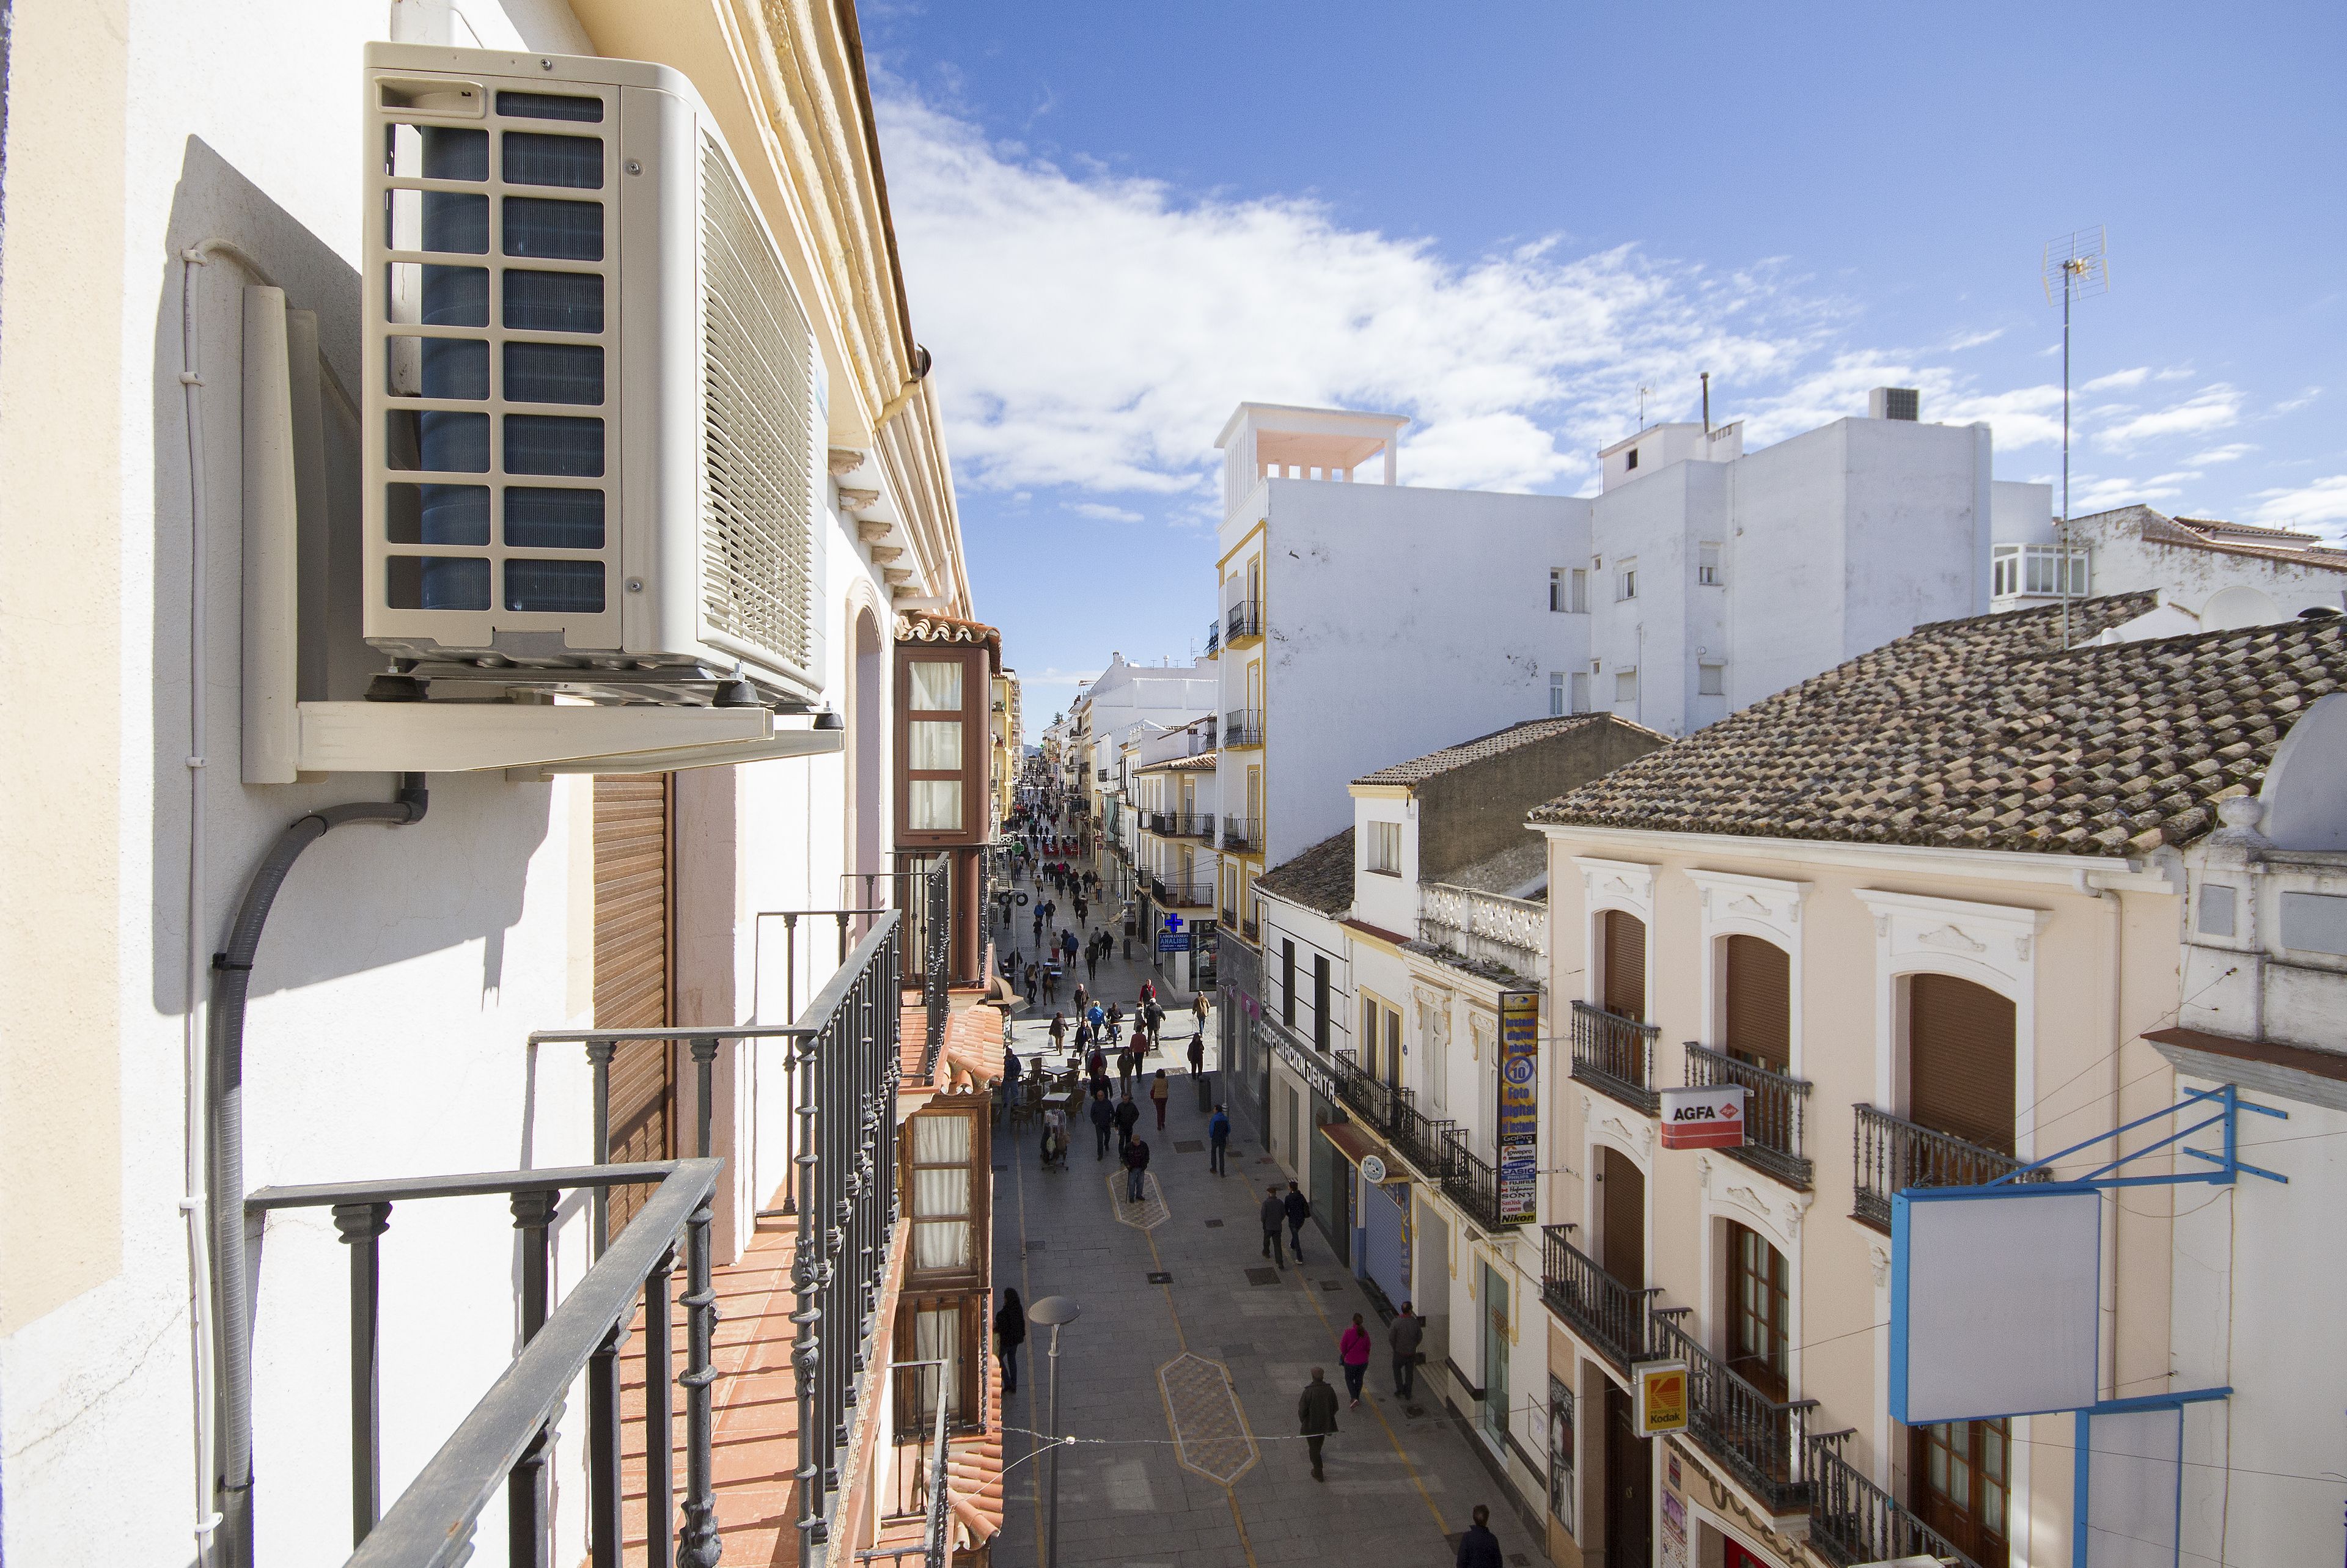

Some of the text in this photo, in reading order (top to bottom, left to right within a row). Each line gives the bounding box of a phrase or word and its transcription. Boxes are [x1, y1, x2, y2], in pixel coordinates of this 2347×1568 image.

[1260, 1020, 1306, 1078] CORPORACION
[1513, 1067, 1526, 1079] 10
[1508, 1086, 1529, 1099] Foto
[1502, 1103, 1535, 1118] Digital
[1673, 1106, 1716, 1121] AGFA
[1502, 1214, 1534, 1223] Nikon
[1650, 1413, 1680, 1424] Kodak
